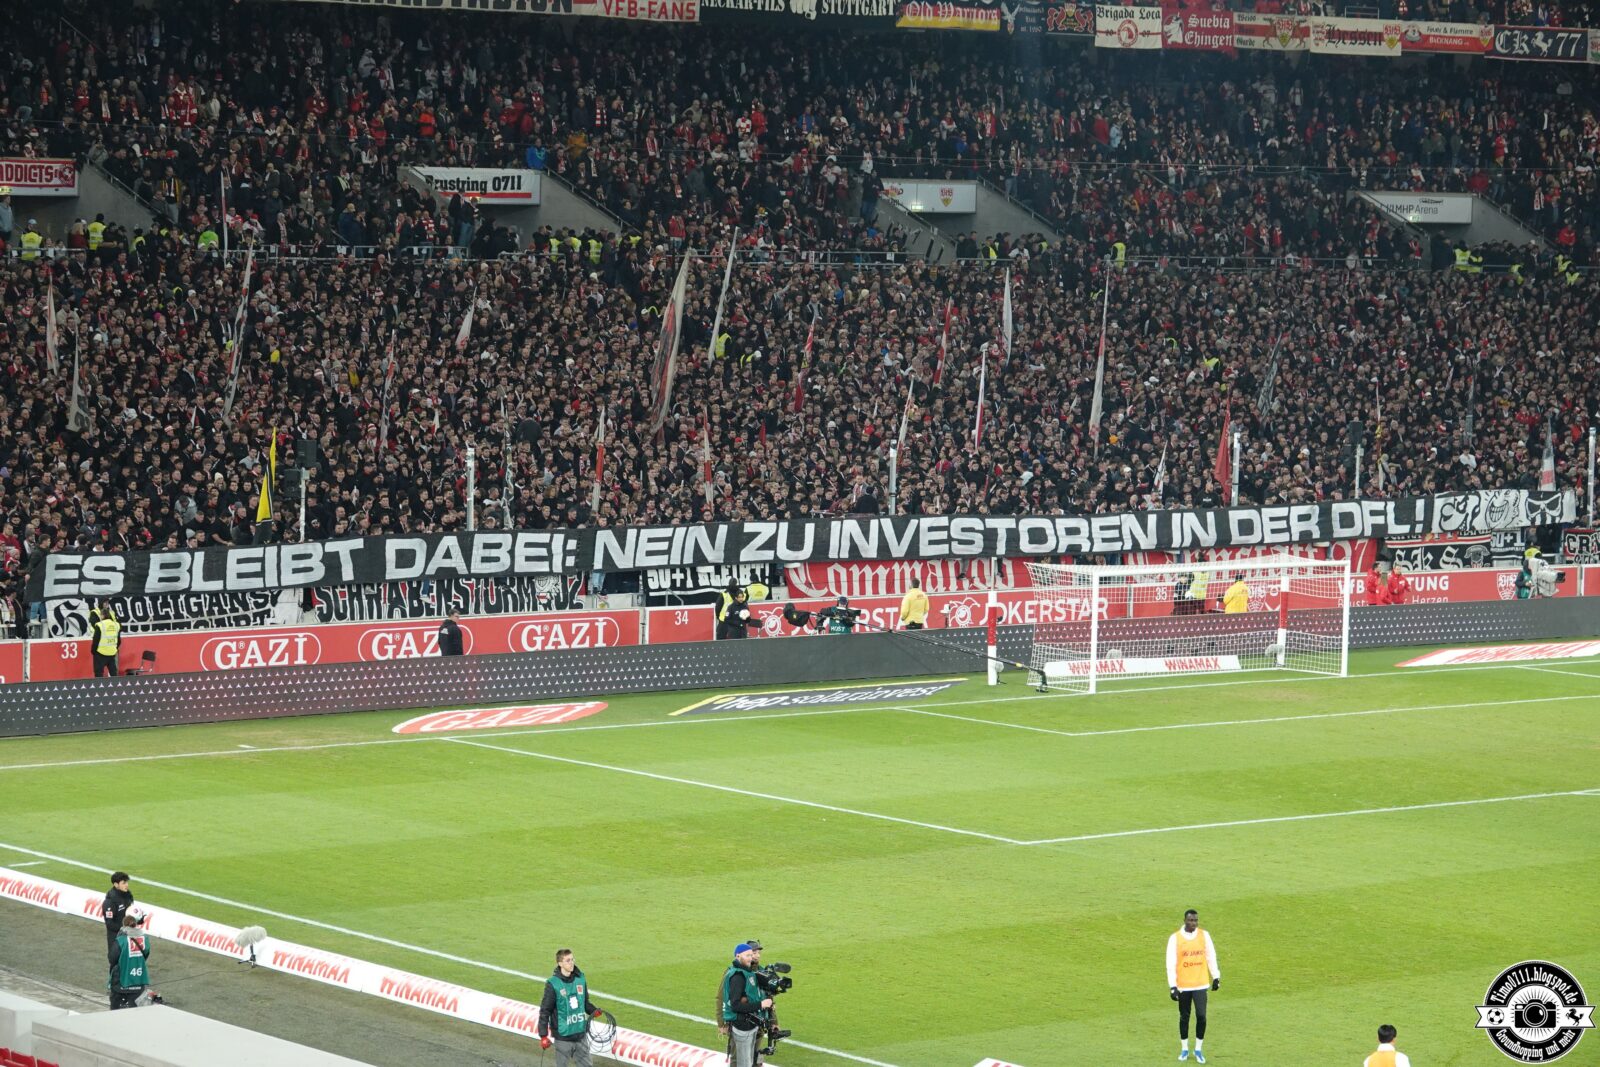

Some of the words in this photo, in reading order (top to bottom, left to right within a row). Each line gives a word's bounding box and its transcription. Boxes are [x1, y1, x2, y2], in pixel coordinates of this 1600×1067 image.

[603, 0, 696, 20] VFB-FANS
[821, 0, 896, 16] STUTTGART
[905, 2, 933, 20] Old
[936, 2, 999, 25] Warriors
[1096, 6, 1135, 20] Brigada
[1139, 8, 1161, 19] Loca
[1188, 14, 1230, 29] Suebia
[1556, 32, 1582, 57] 77
[492, 175, 522, 192] 0711
[44, 555, 126, 597] ES
[145, 537, 364, 594] BLEIBT
[593, 524, 728, 569] NEIN
[739, 522, 815, 562] ZU
[828, 512, 1157, 559] INVESTOREN
[1171, 511, 1217, 548] IN
[1228, 504, 1320, 545] DER
[1331, 498, 1424, 538] DFL!
[1155, 587, 1168, 601] 35
[84, 590, 272, 624] OOLIGANS
[674, 610, 689, 626] 34
[60, 642, 78, 660] 33
[371, 631, 443, 660] GAZ
[1164, 656, 1222, 671] WINAMAX
[129, 967, 143, 977] 46
